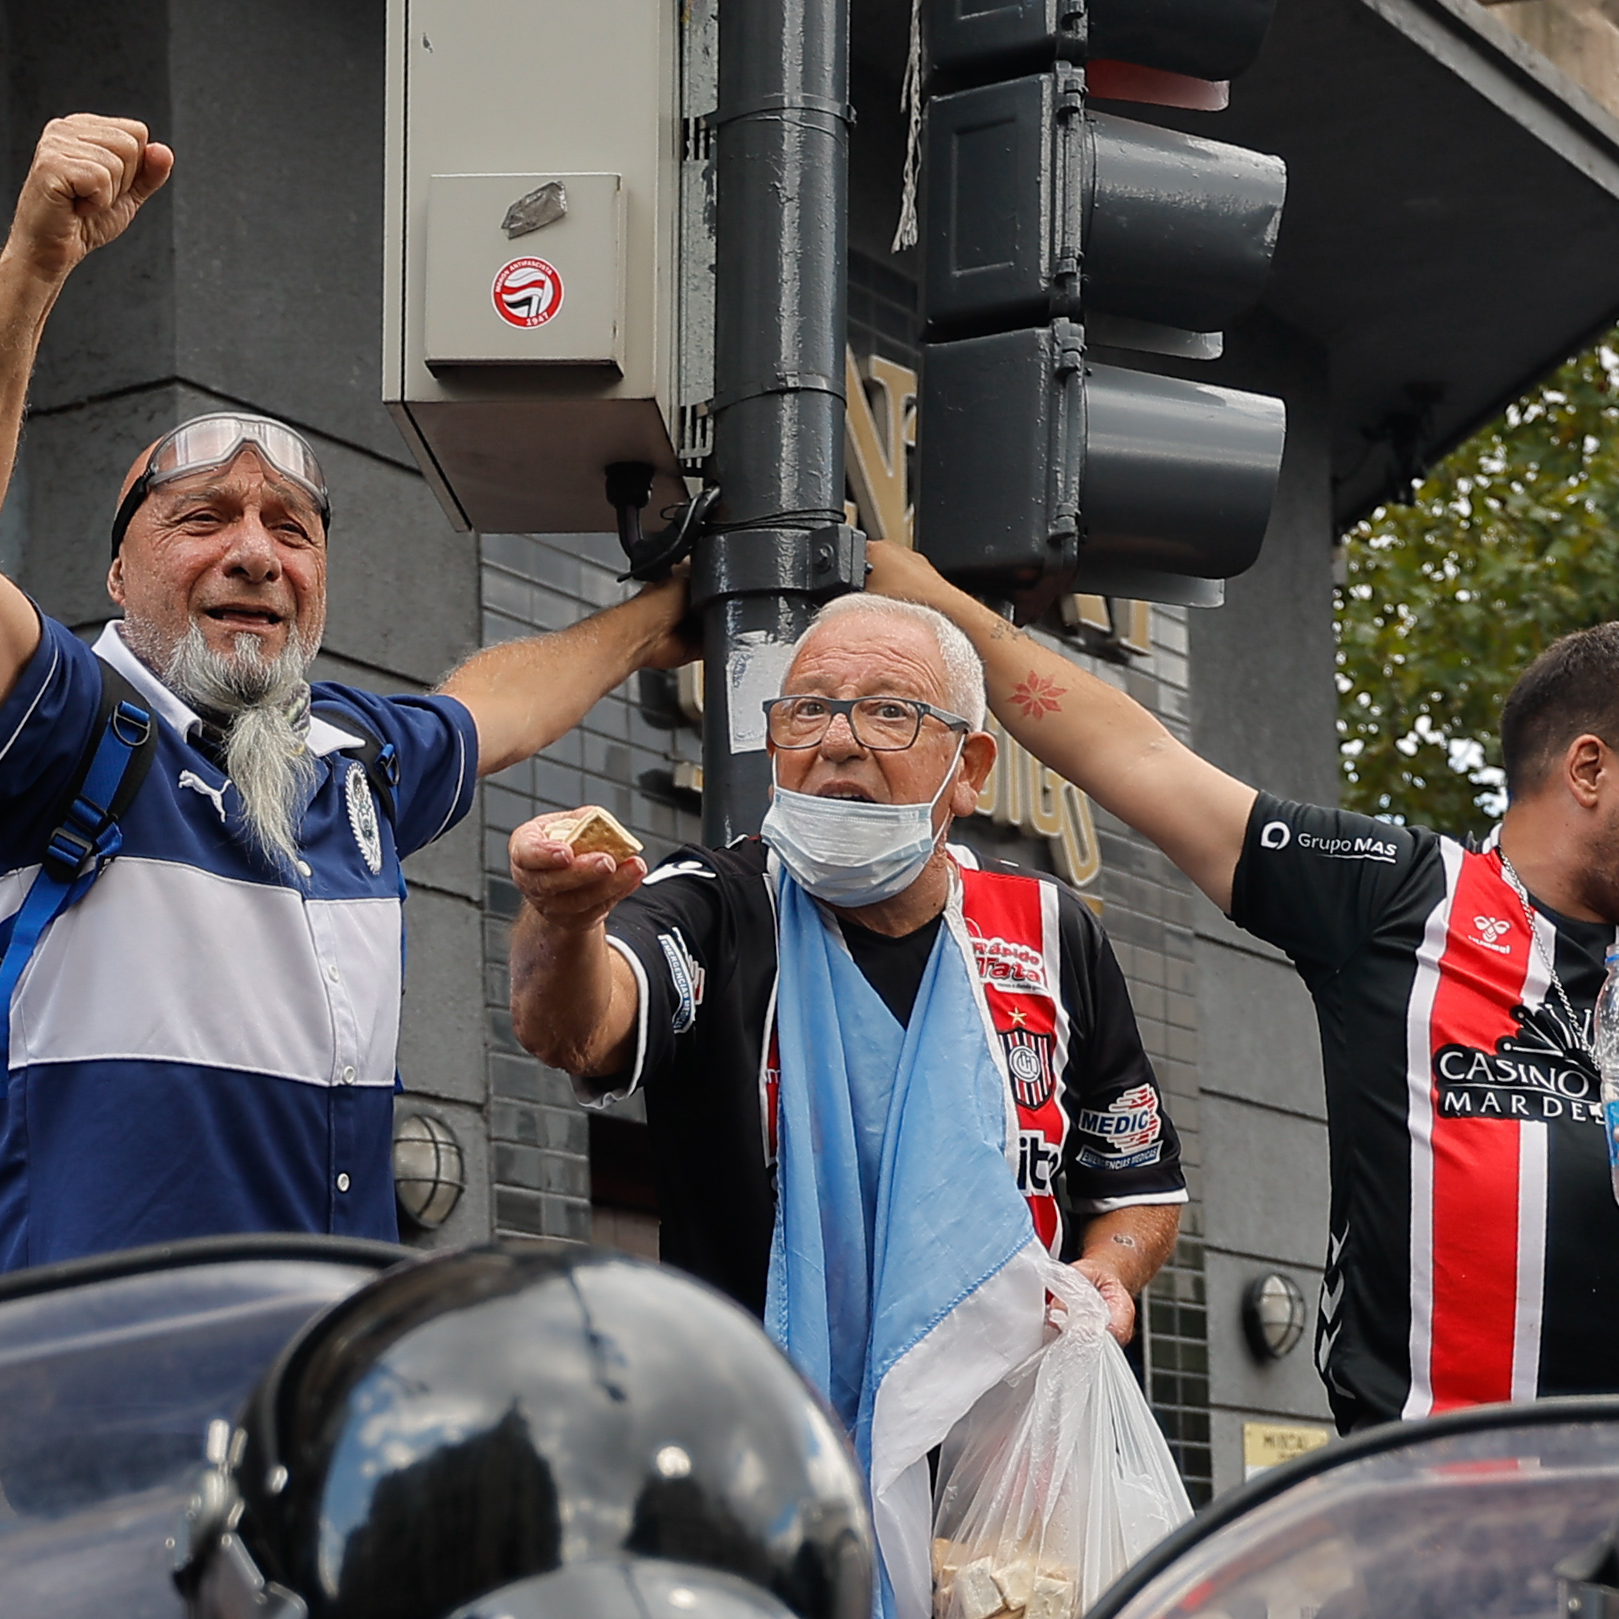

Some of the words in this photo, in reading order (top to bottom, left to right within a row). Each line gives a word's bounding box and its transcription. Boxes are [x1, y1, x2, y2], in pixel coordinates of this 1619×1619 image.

[526, 311, 549, 326] 1947
[1297, 833, 1352, 853] Grupo
[1354, 837, 1398, 857] MAS
[975, 956, 1042, 983] Tata
[1439, 1051, 1590, 1099] CASINO
[1444, 1091, 1530, 1116] MAR
[1080, 1110, 1149, 1136] MEDIC
